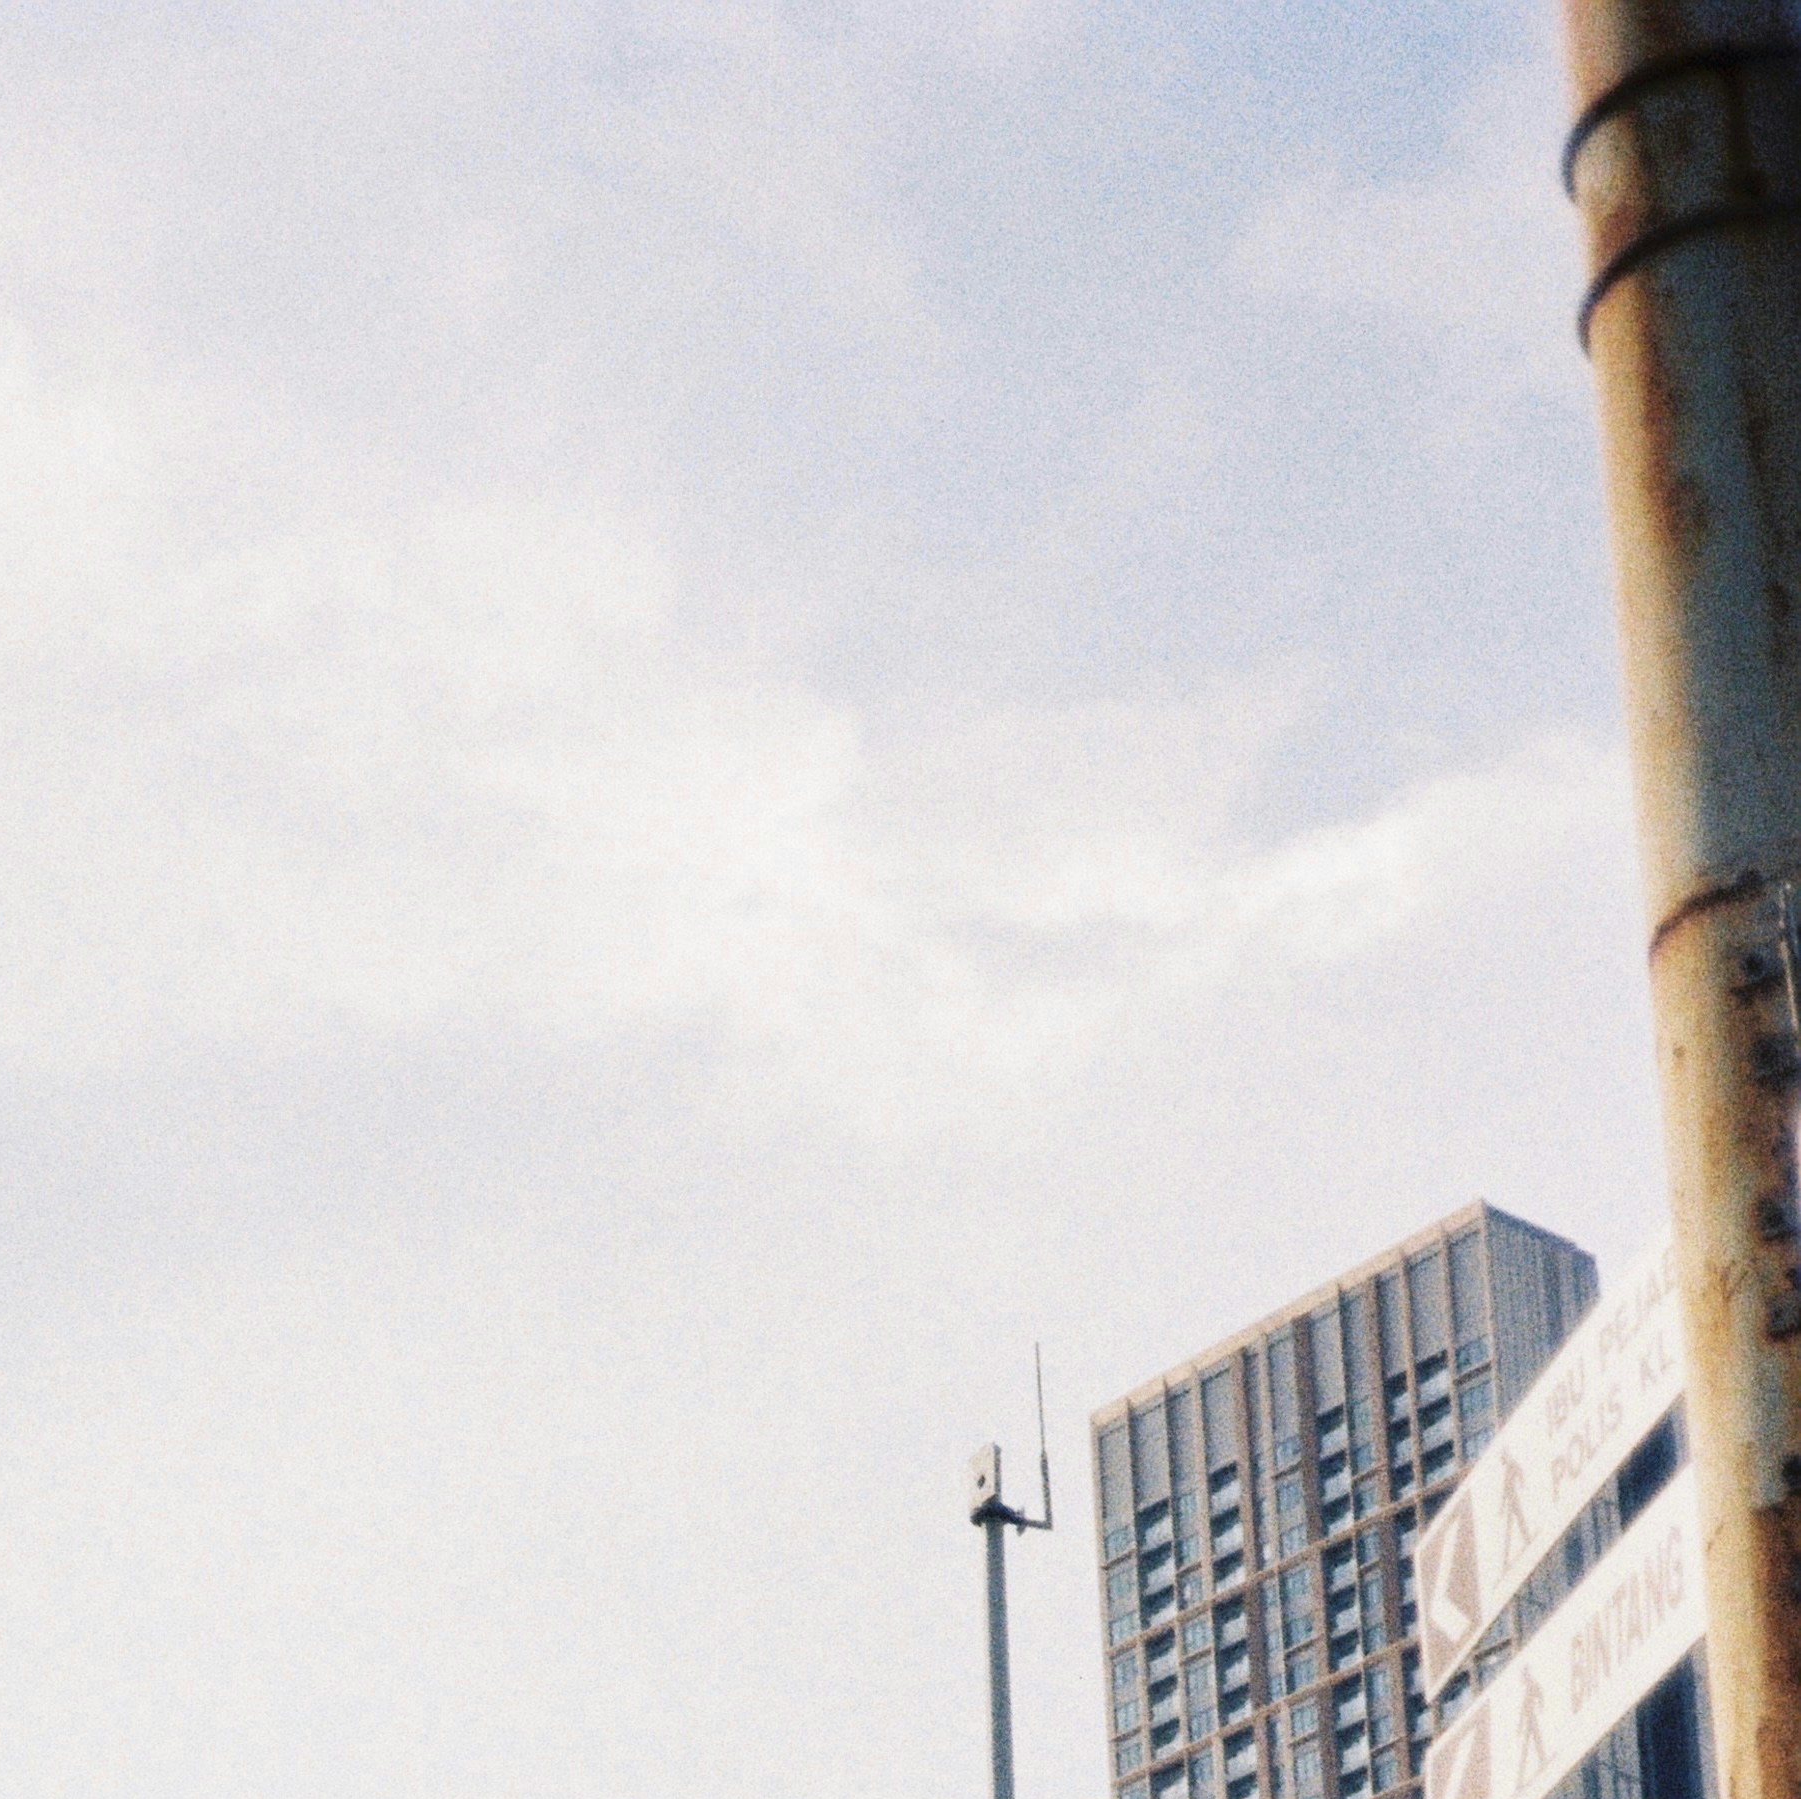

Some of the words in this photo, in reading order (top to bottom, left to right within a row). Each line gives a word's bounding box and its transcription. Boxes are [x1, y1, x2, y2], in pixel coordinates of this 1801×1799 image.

[1545, 1353, 1586, 1439] IBU
[1550, 1383, 1623, 1503] POLIS
[1639, 1330, 1675, 1395] KL
[1568, 1525, 1686, 1716] BINTANG
